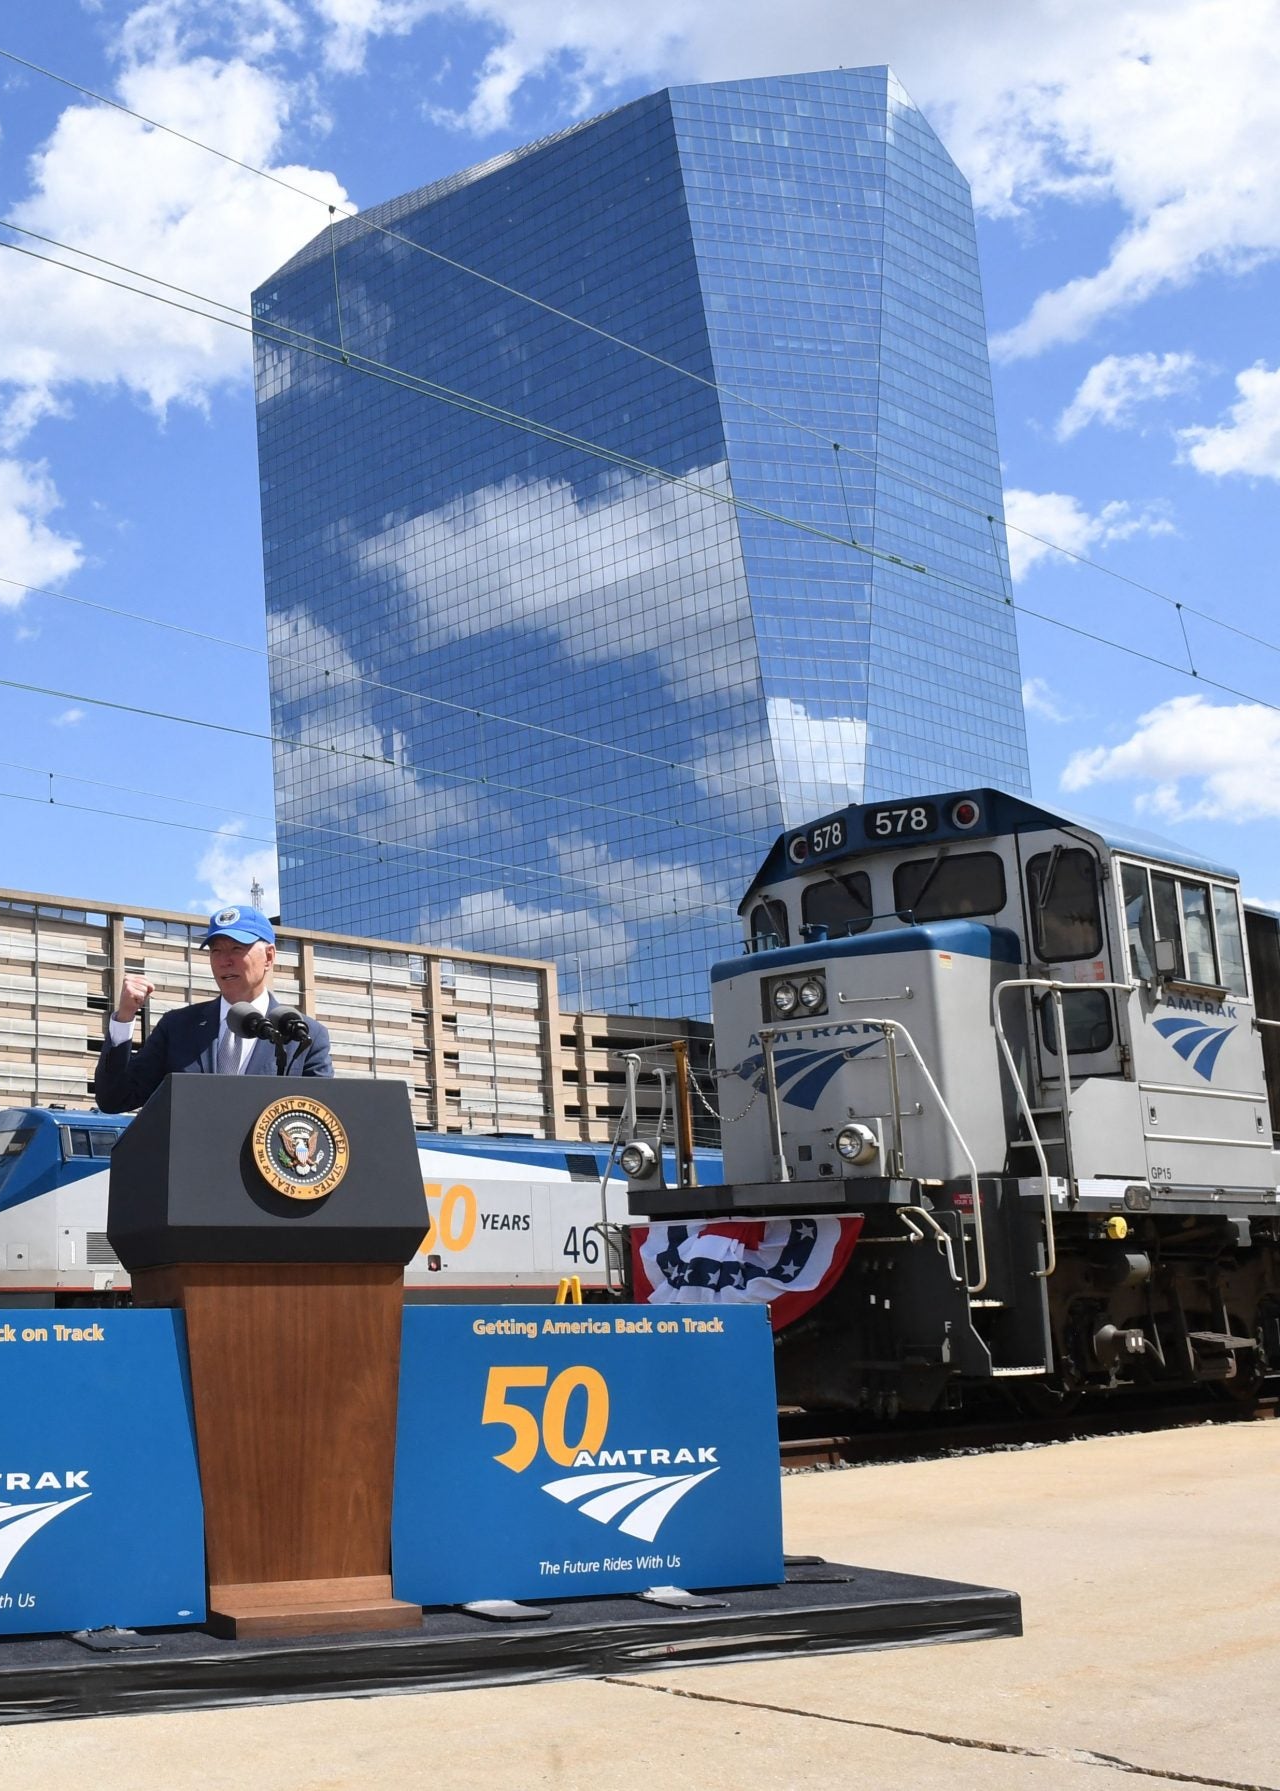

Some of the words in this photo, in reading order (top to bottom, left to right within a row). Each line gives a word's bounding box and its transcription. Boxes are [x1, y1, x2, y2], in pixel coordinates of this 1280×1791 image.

[874, 807, 928, 835] 578
[813, 821, 842, 852] 578
[1166, 995, 1237, 1019] AMTRAK
[256, 1100, 295, 1145] PRESIDENT
[322, 1111, 346, 1154] UNITED
[312, 1163, 343, 1195] STATES
[1151, 1166, 1172, 1180] GP15
[271, 1174, 296, 1195] SEAL
[480, 1213, 531, 1231] YEARS
[563, 1225, 599, 1265] 46
[22, 1328, 48, 1342] on
[53, 1323, 105, 1342] Track
[473, 1318, 538, 1338] Getting
[542, 1318, 611, 1334] America
[615, 1318, 654, 1334] Back
[657, 1321, 679, 1334] on
[683, 1317, 724, 1333] Track
[944, 1321, 952, 1333] F
[481, 1365, 610, 1473] 50
[573, 1447, 719, 1468] AMTRAK
[539, 1561, 560, 1575] The
[563, 1560, 600, 1574] Future
[602, 1557, 633, 1572] Rides
[636, 1555, 663, 1570] With
[666, 1555, 680, 1568] Us
[18, 1593, 35, 1608] Us
